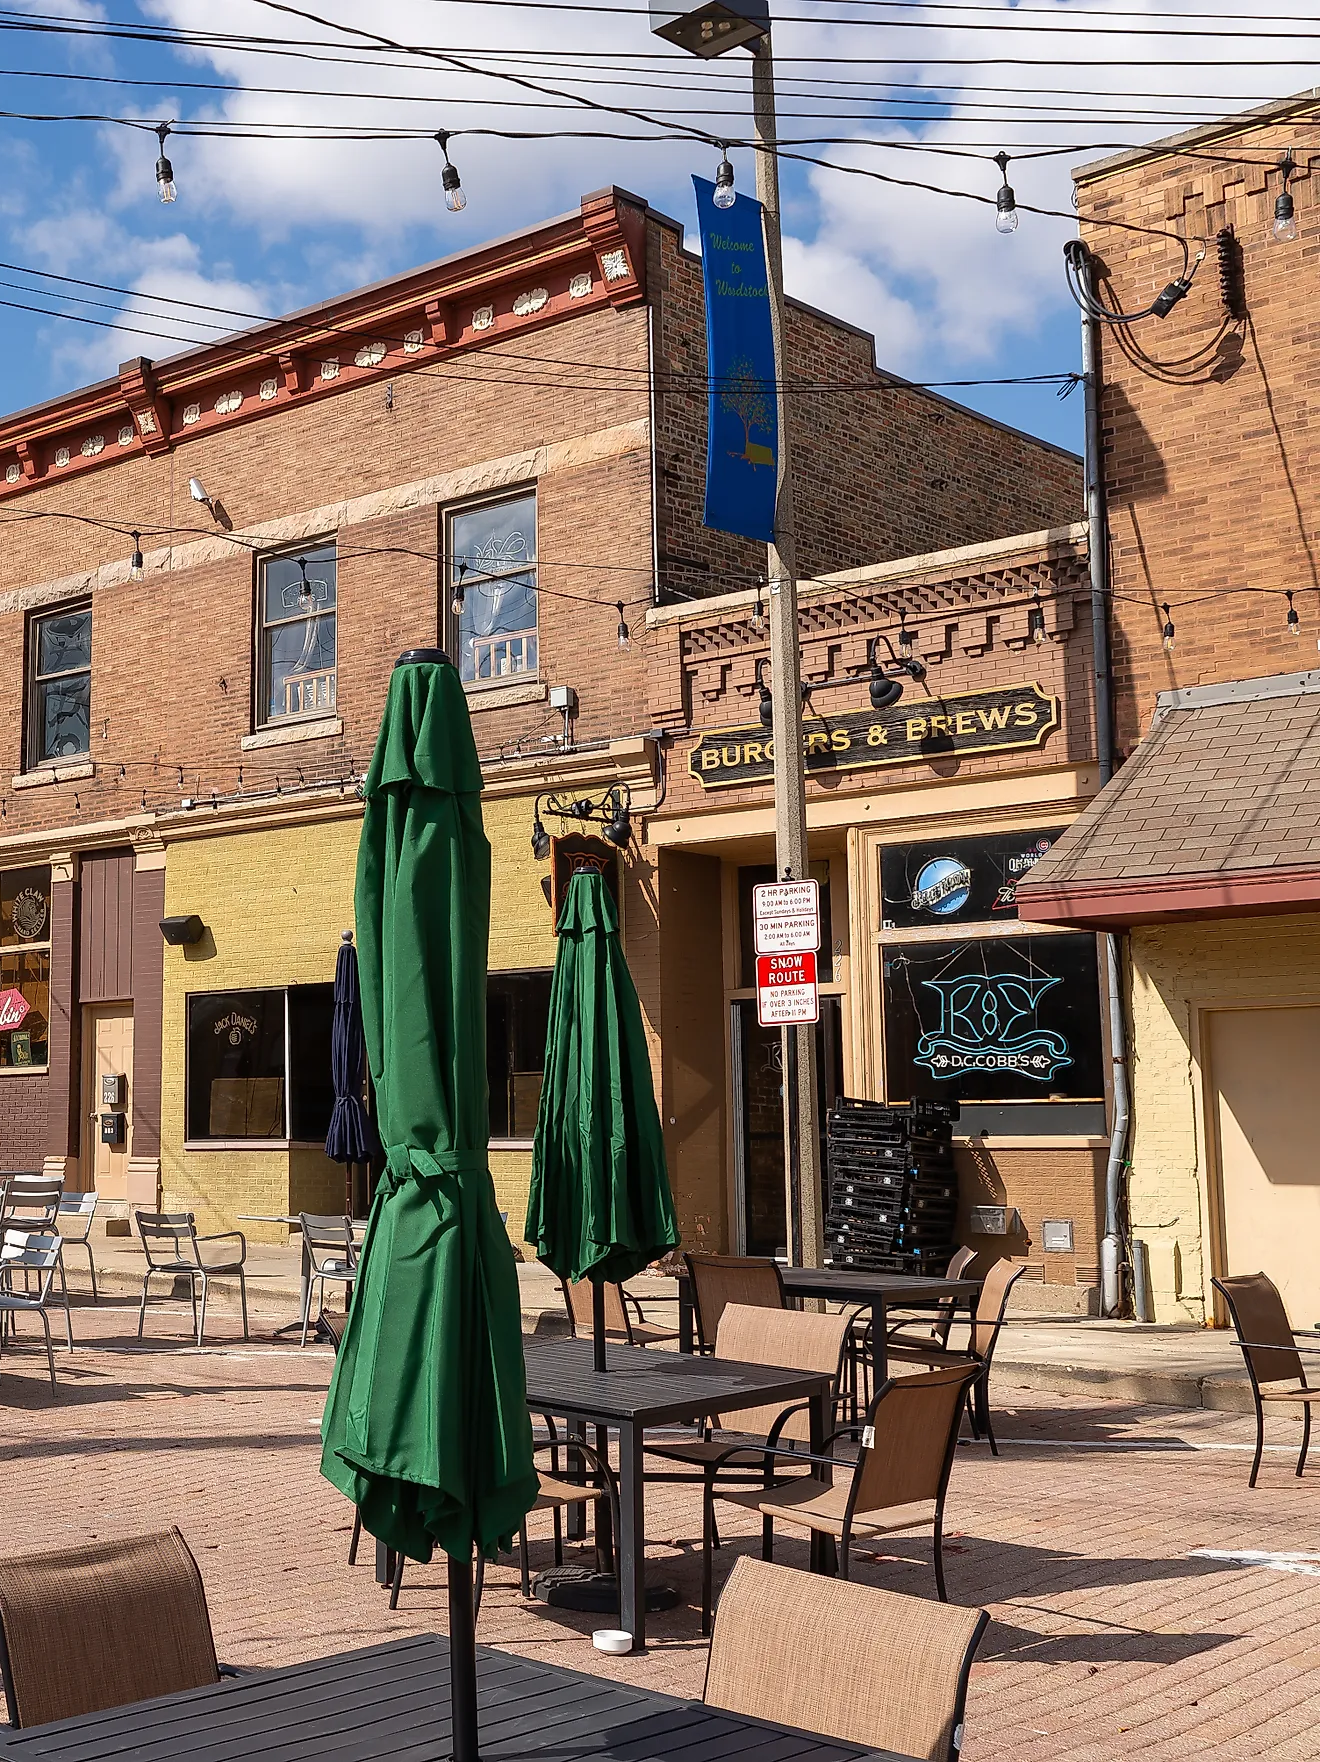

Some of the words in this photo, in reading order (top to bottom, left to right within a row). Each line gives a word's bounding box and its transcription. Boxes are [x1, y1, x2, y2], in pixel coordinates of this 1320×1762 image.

[710, 233, 755, 252] Welcome
[731, 262, 743, 274] to
[867, 724, 888, 746] &
[906, 703, 1038, 743] BREWS
[767, 889, 778, 897] HR
[779, 886, 811, 896] PARKING
[12, 891, 25, 923] WHITE
[24, 887, 45, 903] CLAW
[759, 923, 769, 931] 30
[770, 922, 783, 930] MIN
[784, 919, 815, 928] PARKING
[770, 955, 803, 970] SNOW
[768, 969, 806, 984] ROUTE
[770, 990, 779, 998] NO
[780, 988, 806, 997] PARKING
[769, 999, 786, 1008] OVER
[787, 999, 792, 1007] 3
[793, 997, 814, 1006] INCHES
